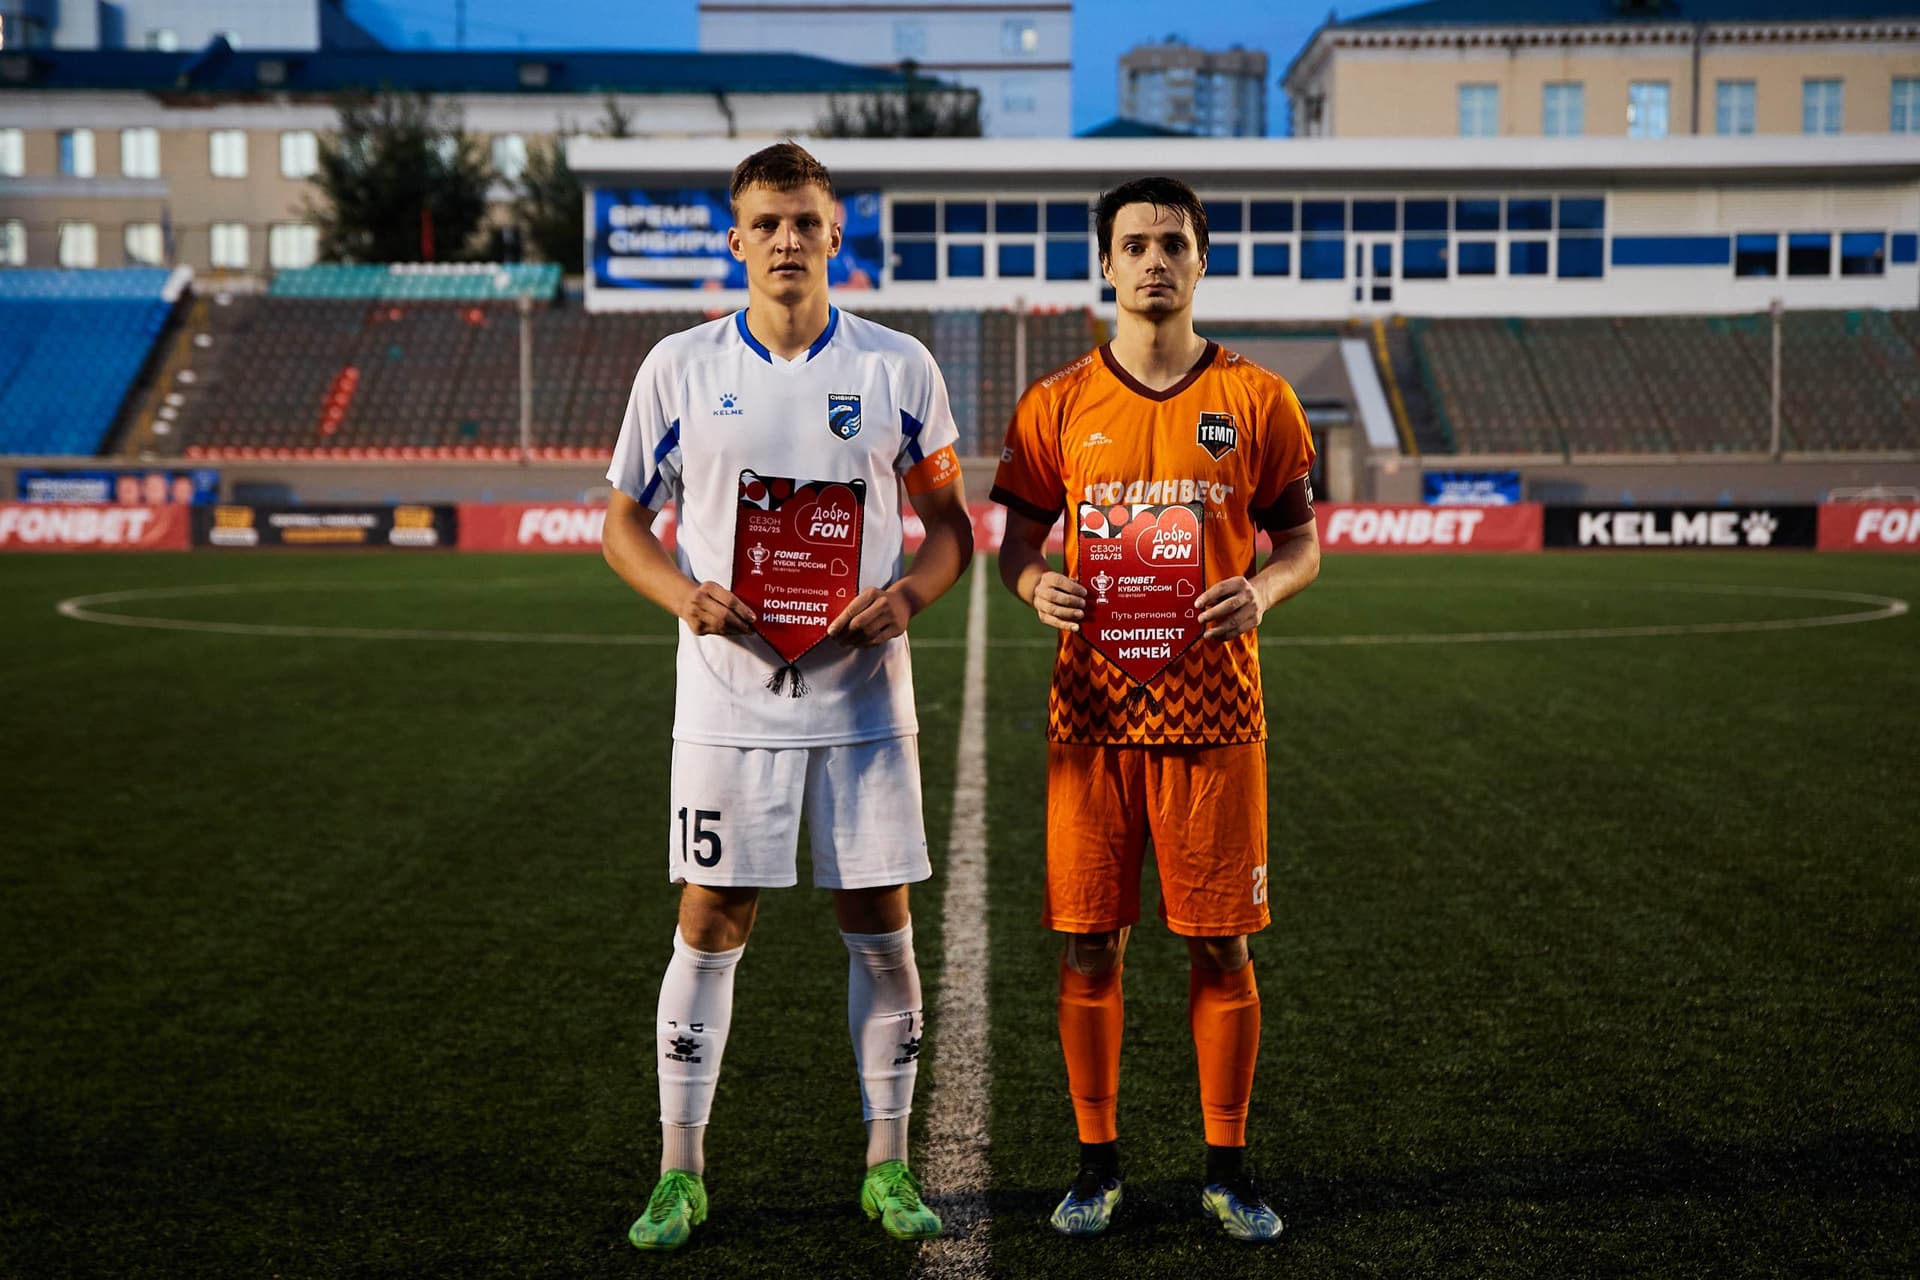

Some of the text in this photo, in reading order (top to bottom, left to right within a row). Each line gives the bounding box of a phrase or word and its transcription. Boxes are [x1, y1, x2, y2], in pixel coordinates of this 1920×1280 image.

[1201, 425, 1235, 445] ТЕМП
[811, 502, 850, 522] Добро
[0, 507, 152, 543] FONBET
[518, 509, 675, 544] FONT
[749, 515, 781, 525] СЕЗОН
[1326, 509, 1484, 544] FONBET
[749, 525, 780, 533] 2024/25
[809, 522, 850, 539] FON
[1152, 523, 1192, 544] Добро
[1579, 511, 1740, 545] KELME
[774, 550, 812, 560] FONBET
[1090, 544, 1122, 553] СЕЗОН
[1151, 544, 1192, 560] FON
[798, 561, 827, 570] РОССИИ
[1118, 576, 1156, 585] FONBET
[764, 584, 829, 596] Путь регионов
[763, 599, 829, 612] КОМПЛЕКТ
[763, 613, 828, 626] ИНВЕНТАРЯ
[1112, 611, 1177, 621] Путь регионов
[1101, 628, 1185, 641] КОМПЛЕКТ
[1119, 643, 1171, 659] МЯЧЕЙ
[678, 807, 722, 868] 15
[1252, 864, 1267, 905] 2
[665, 1052, 702, 1064] KELME
